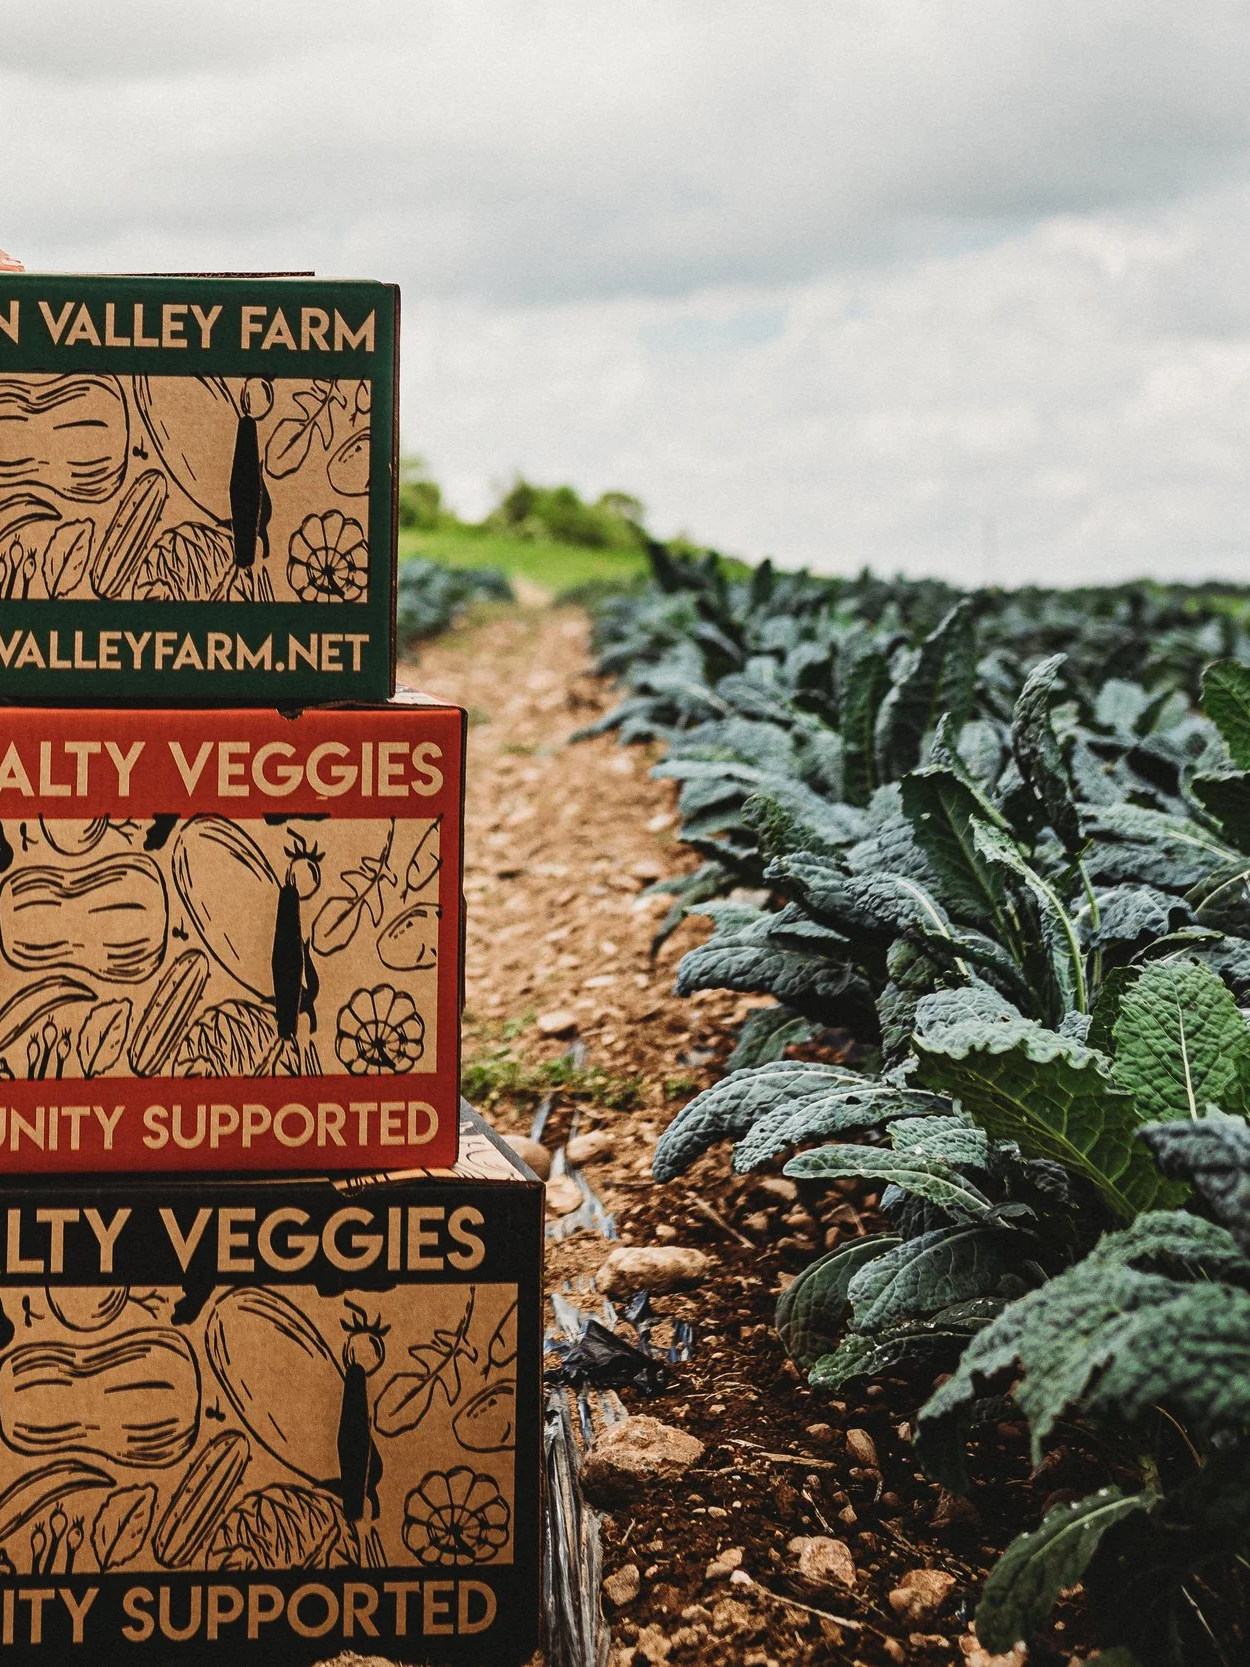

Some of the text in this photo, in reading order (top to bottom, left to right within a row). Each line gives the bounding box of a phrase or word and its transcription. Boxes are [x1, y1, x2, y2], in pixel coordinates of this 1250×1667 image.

[37, 302, 223, 349] VALLEY
[241, 306, 375, 352] FARM
[168, 741, 444, 798] VEGGIES
[142, 1102, 439, 1150] SUPPORTED
[159, 1207, 486, 1273] VEGGIES
[121, 1580, 498, 1642] SUPPORTED
